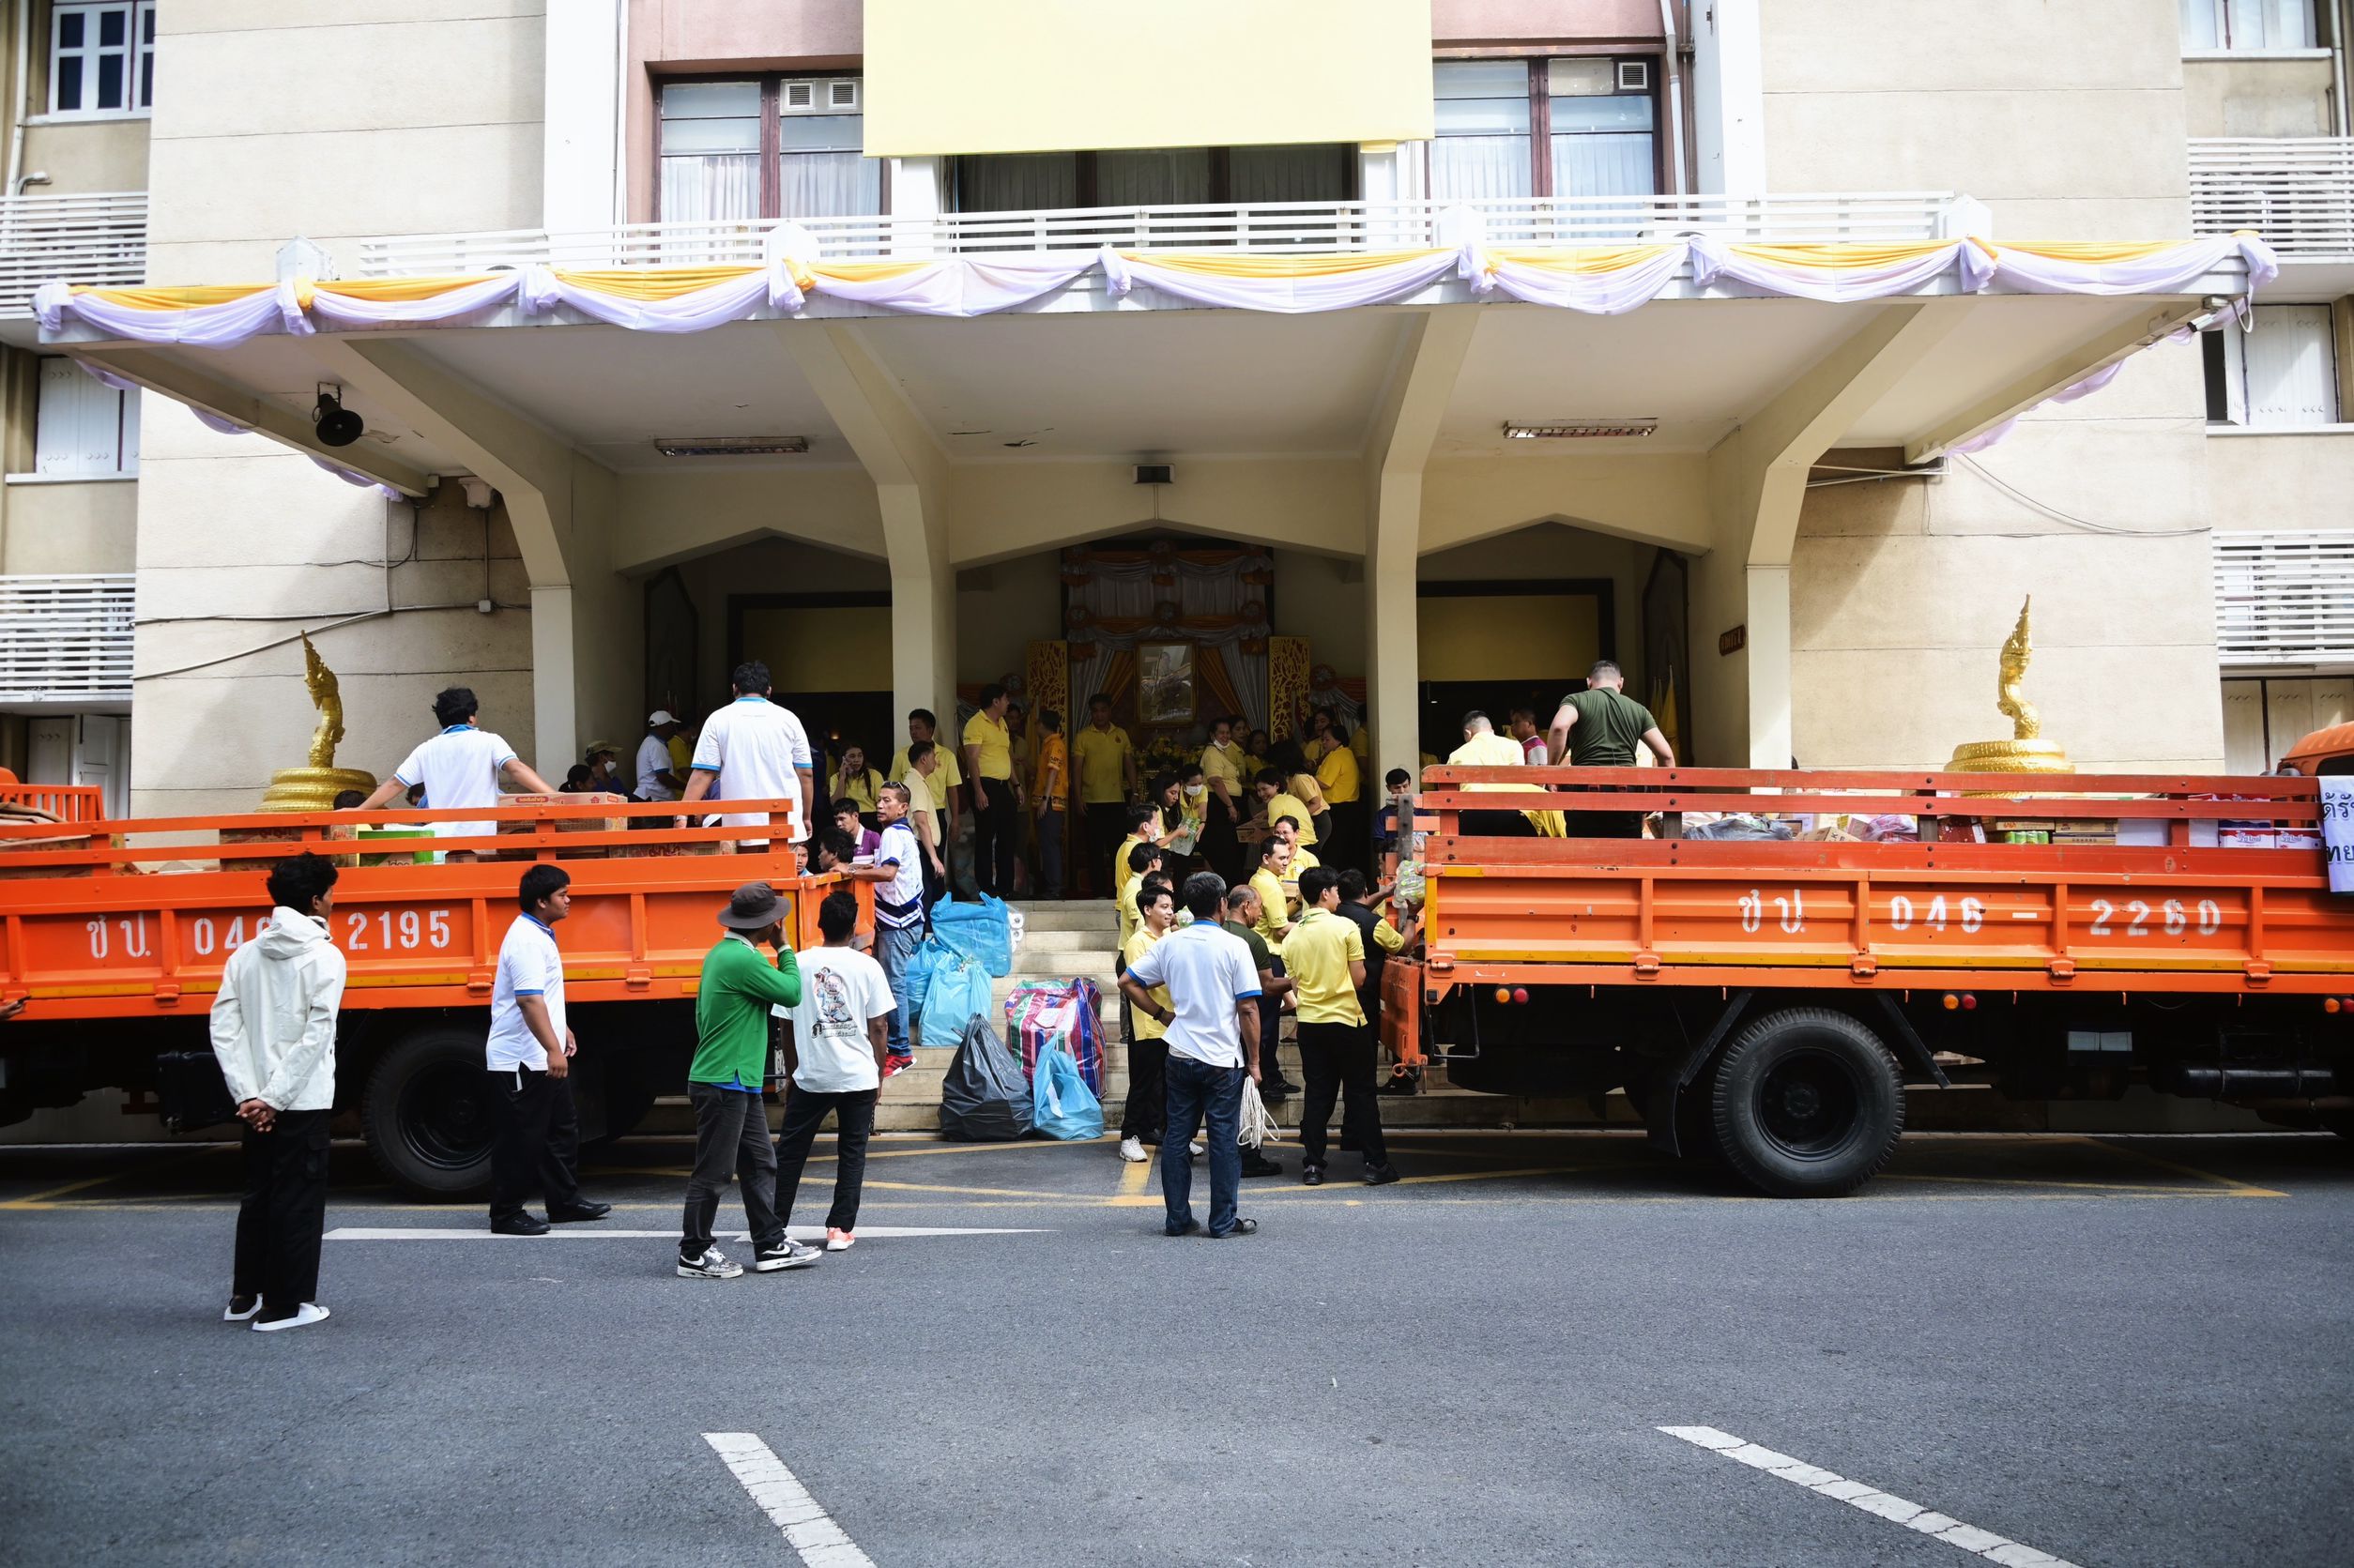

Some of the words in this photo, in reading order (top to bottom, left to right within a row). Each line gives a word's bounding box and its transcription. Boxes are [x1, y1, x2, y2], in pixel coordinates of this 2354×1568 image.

[347, 909, 451, 951] 2195
[1890, 894, 1983, 934] 046
[2089, 898, 2222, 936] 2260
